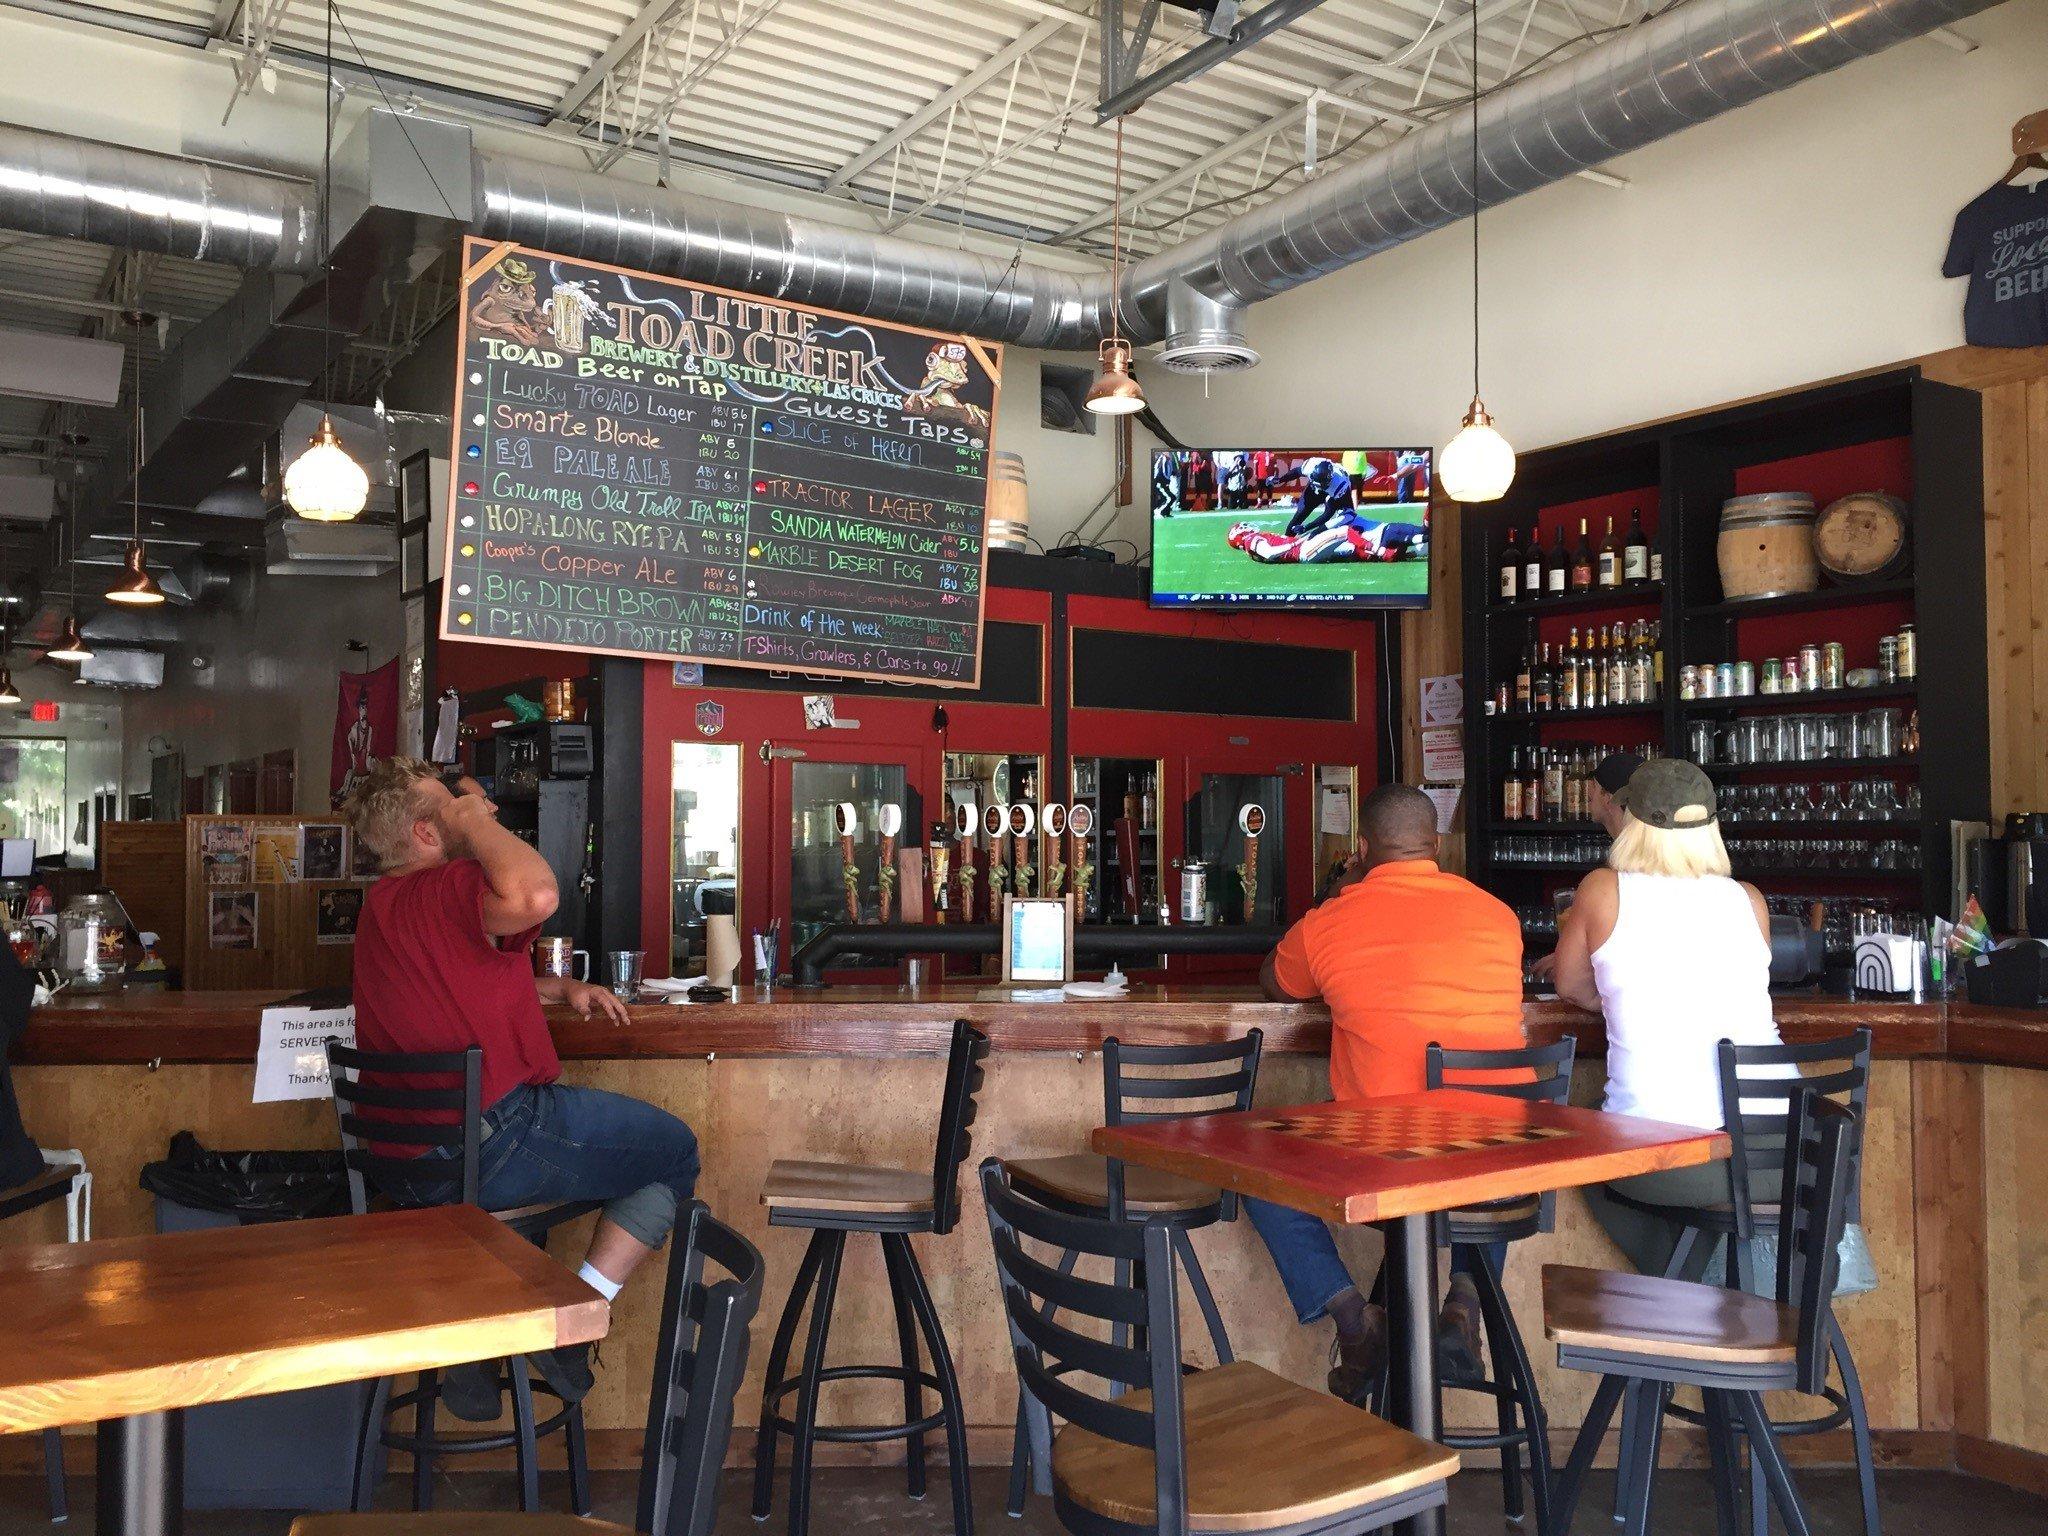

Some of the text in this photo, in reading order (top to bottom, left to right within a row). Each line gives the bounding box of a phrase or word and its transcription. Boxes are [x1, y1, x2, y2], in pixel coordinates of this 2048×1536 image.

[1992, 217, 2048, 245] SUPPO
[689, 290, 818, 344] LITTLE
[607, 301, 888, 392] TOAD CREEK
[479, 337, 727, 401] TOAD Beer on Tap
[590, 336, 904, 411] BREWERY & DISTILLERY LAS CRUCES
[503, 370, 698, 424] Lucky TOAD Lager
[711, 405, 729, 417] ABV
[785, 397, 889, 428] Guest
[494, 404, 665, 449] Smarte Blonde
[711, 418, 744, 435] IBU 17
[699, 433, 736, 449] ABV 5
[699, 447, 740, 460] IBU 20
[554, 445, 619, 480] PALE
[623, 456, 672, 486] ALE
[696, 465, 719, 478] ABV
[695, 478, 740, 492] IBU 30
[492, 471, 716, 525] Grumpy Old Troll IPA
[716, 500, 733, 511] ABV
[769, 479, 936, 523] TRACTOR LAGER
[718, 512, 733, 523] IBU
[701, 529, 742, 544] ABV 5.8
[837, 520, 906, 550] WATERMELON
[909, 533, 942, 555] Cider
[941, 535, 980, 554] ABV 5.6
[484, 538, 536, 563] Cooper's
[541, 545, 626, 578] Copper
[703, 544, 721, 556] IBU
[943, 549, 958, 558] IBU
[757, 540, 923, 583] MARBLE DESERT FOG
[939, 562, 959, 574] ABV
[703, 567, 737, 581] ABV 6
[703, 580, 739, 595] IBU 29
[940, 577, 979, 593] IBU 35
[484, 574, 706, 624] BIG DITCH BROWN
[709, 597, 729, 610] ABV
[940, 593, 962, 605] ABV
[708, 612, 739, 626] IBU 22
[744, 604, 794, 629] Drink
[800, 609, 815, 632] of
[819, 613, 847, 637] the
[614, 620, 694, 653] PORTER
[698, 628, 717, 640] ABV
[698, 642, 732, 653] IBU 27
[912, 651, 927, 671] to
[282, 1021, 304, 1031] This
[307, 1020, 332, 1029] area
[335, 1018, 345, 1028] is
[280, 1034, 356, 1049] SERVER onl
